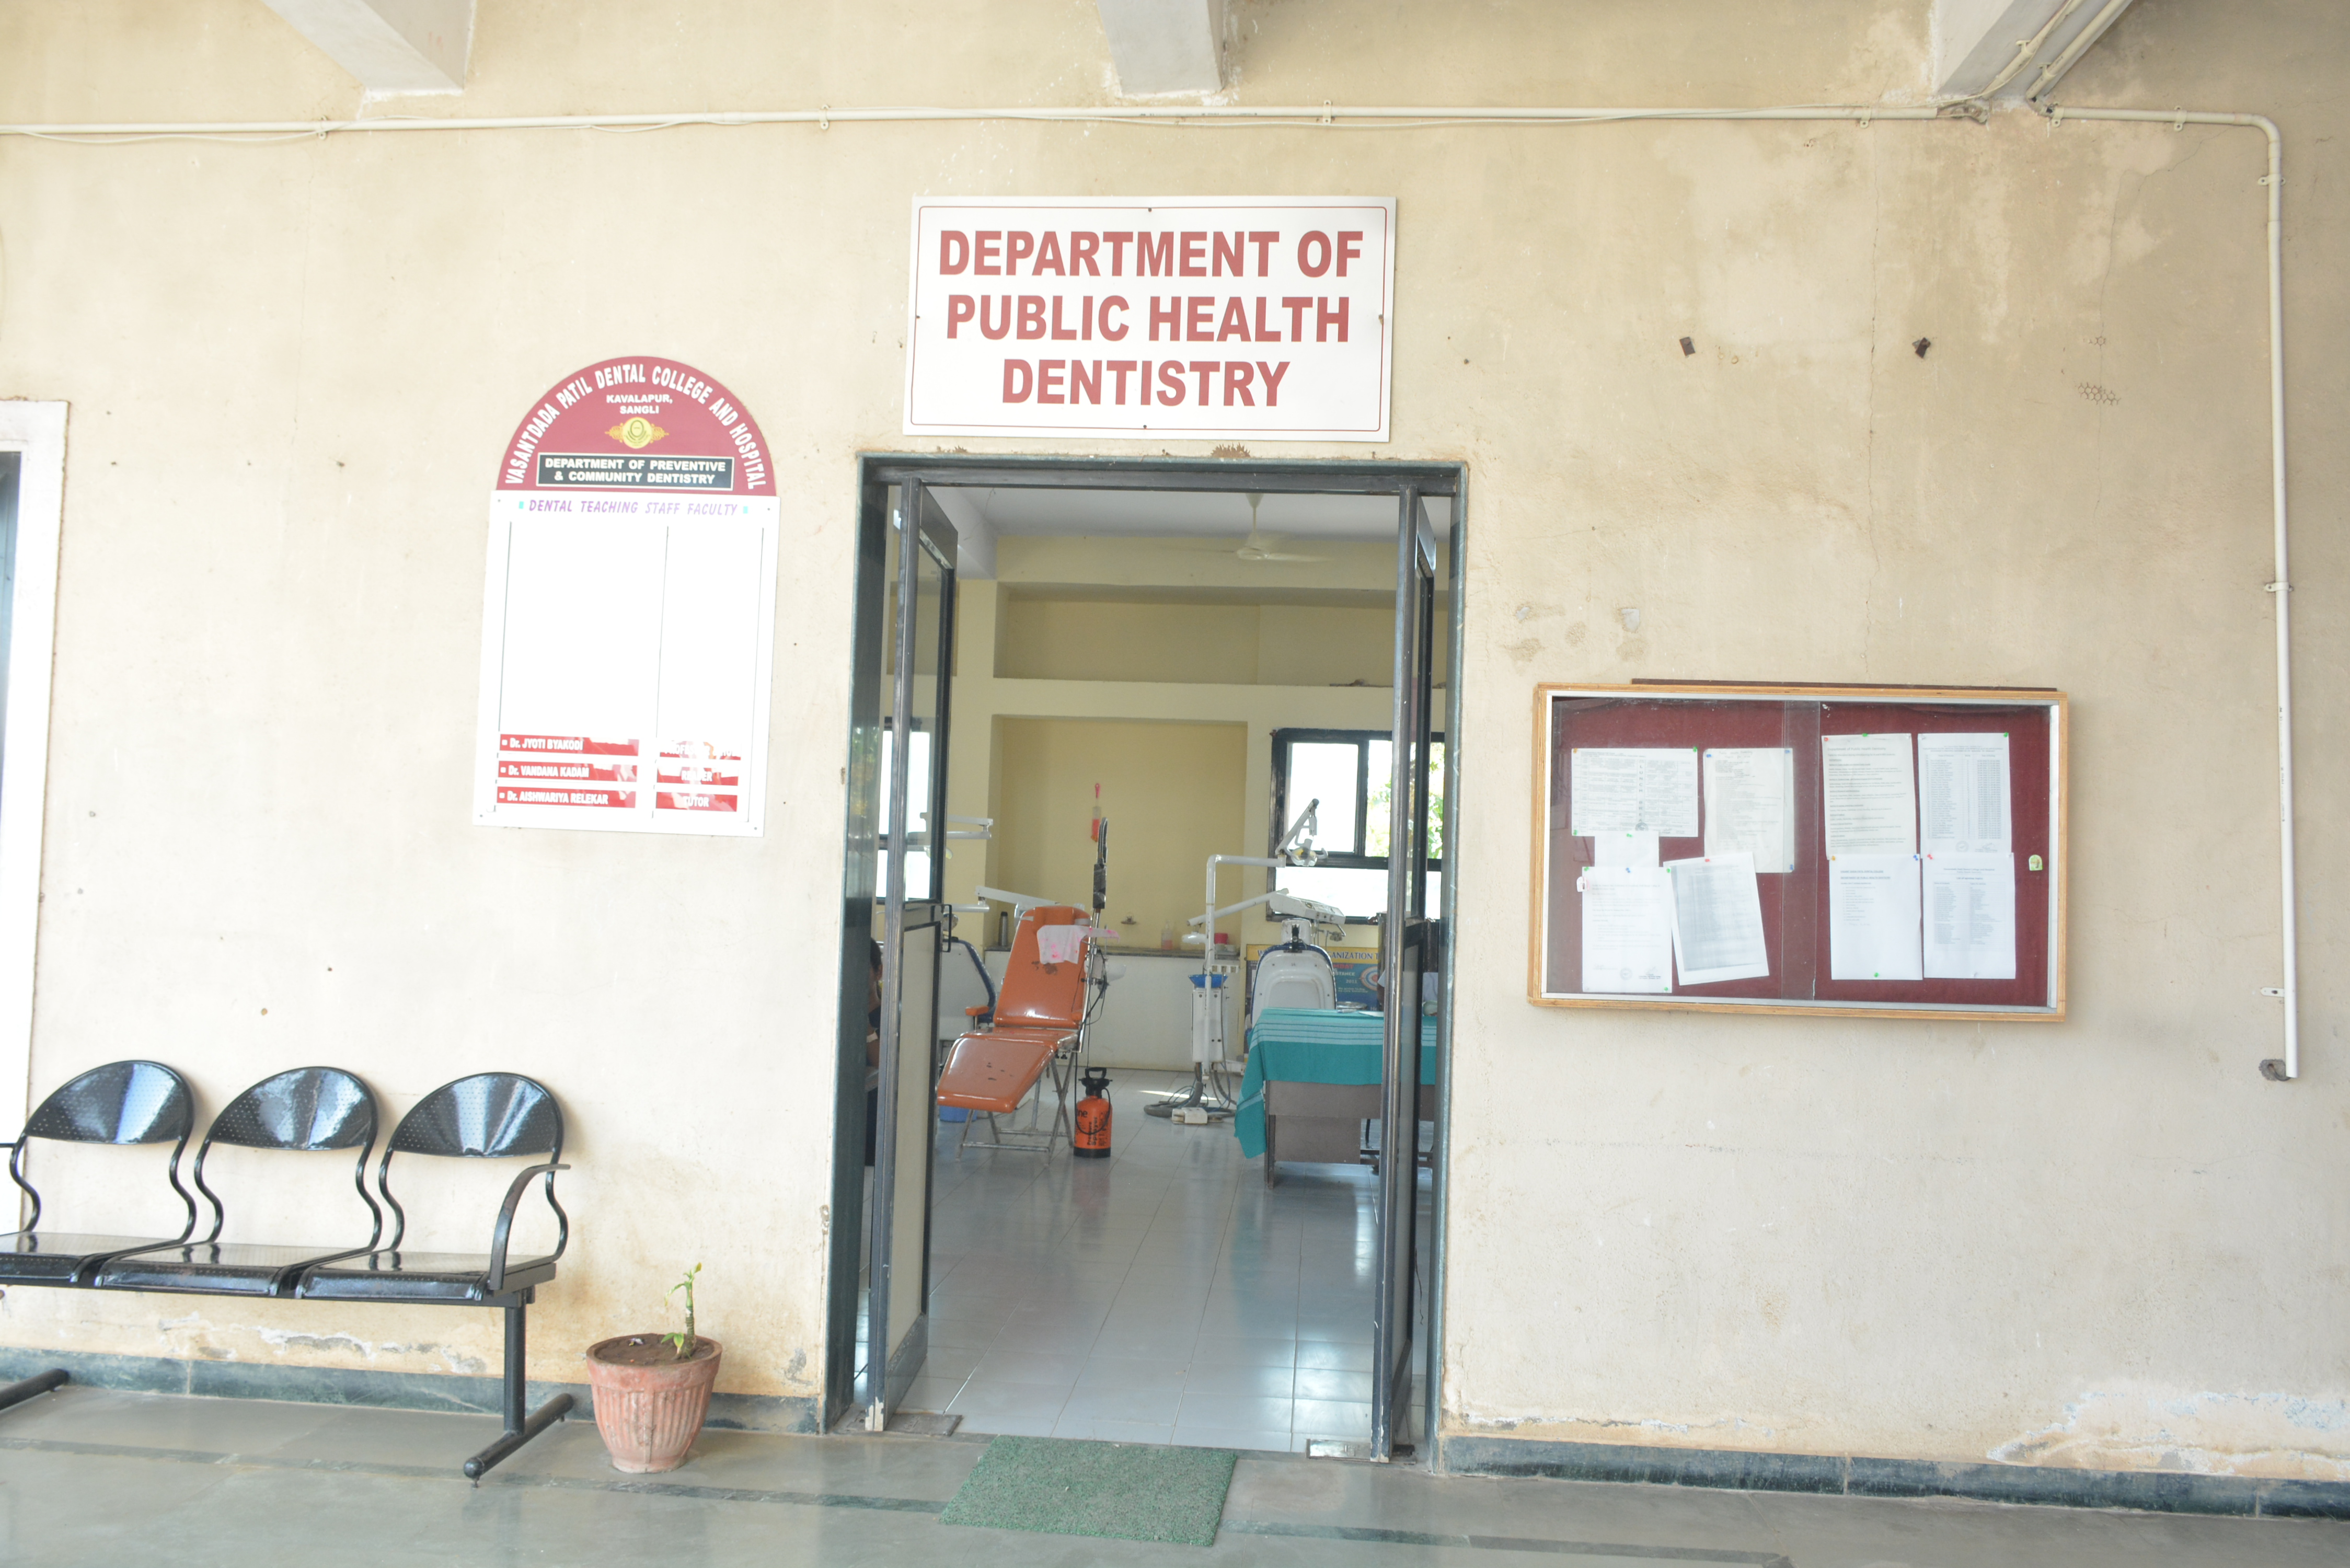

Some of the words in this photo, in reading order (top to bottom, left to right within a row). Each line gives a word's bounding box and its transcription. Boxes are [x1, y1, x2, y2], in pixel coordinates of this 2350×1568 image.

[939, 230, 1280, 278] DEPARTMENT
[1298, 230, 1363, 278] OF
[947, 294, 1130, 342] PUBLIC
[1149, 296, 1350, 342] HEALTH
[1002, 359, 1291, 407] DENTISTRY
[606, 394, 673, 404] KAVALAPUR,
[620, 405, 659, 414] SANGLI
[505, 402, 560, 484] VASANTDADA
[556, 376, 593, 409] PATIL
[594, 364, 646, 389] DENTAL
[651, 365, 713, 404] COLLEGE
[708, 397, 739, 426] AND
[729, 422, 766, 490] HOSPITAL
[545, 458, 624, 470] DEPARTMENT
[628, 459, 646, 470] OF
[650, 460, 726, 472] PREVENTIVE
[554, 471, 563, 481] &
[568, 471, 642, 482] COMMUNITY
[647, 472, 715, 485] DENTISTRY
[528, 500, 572, 512] DENTAL
[581, 500, 638, 514] TEACHING
[645, 502, 680, 515] STAFF
[687, 502, 738, 516] FACULTY
[510, 737, 521, 748] Dr.
[522, 738, 546, 750] JYOTI
[547, 739, 584, 751] BYAKODI
[508, 765, 520, 775] Dr.
[521, 765, 559, 777] VANDANA
[560, 766, 590, 778] KADAM
[507, 790, 518, 801] Dr.
[519, 791, 569, 803] AISHWARIYA
[570, 793, 609, 805] RELEKAR
[683, 795, 710, 808] TUTOR
